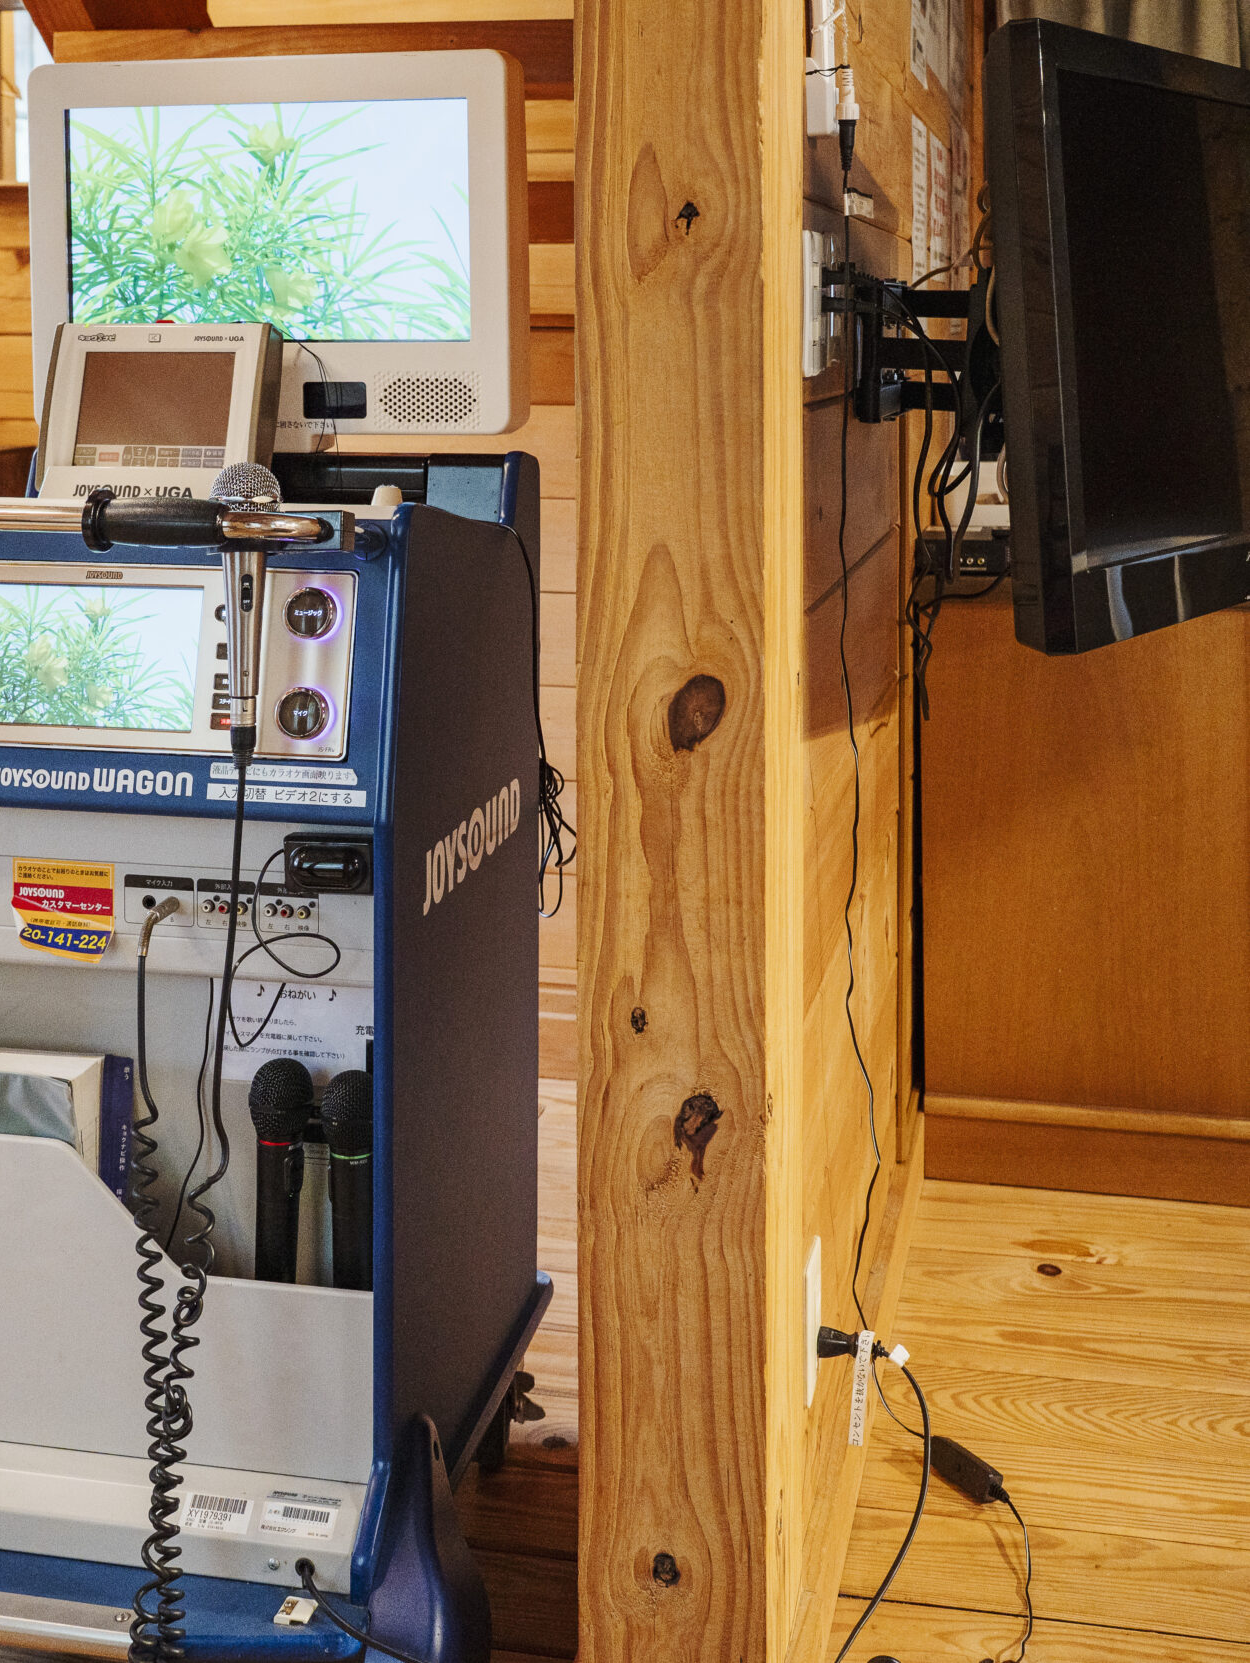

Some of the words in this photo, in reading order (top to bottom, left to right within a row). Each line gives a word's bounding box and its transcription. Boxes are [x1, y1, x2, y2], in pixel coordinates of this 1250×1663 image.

[155, 486, 193, 498] UGA
[293, 608, 323, 616] ミュージック
[292, 709, 308, 717] マイク
[93, 767, 194, 797] WAGON
[274, 789, 353, 805] ビデオ2にする
[422, 778, 521, 917] JOYSOUND
[18, 886, 65, 899] JOYSOUND
[41, 899, 111, 912] カスタマーセンター
[280, 988, 317, 1000] おねがい
[186, 1508, 233, 1523] XY1979391
